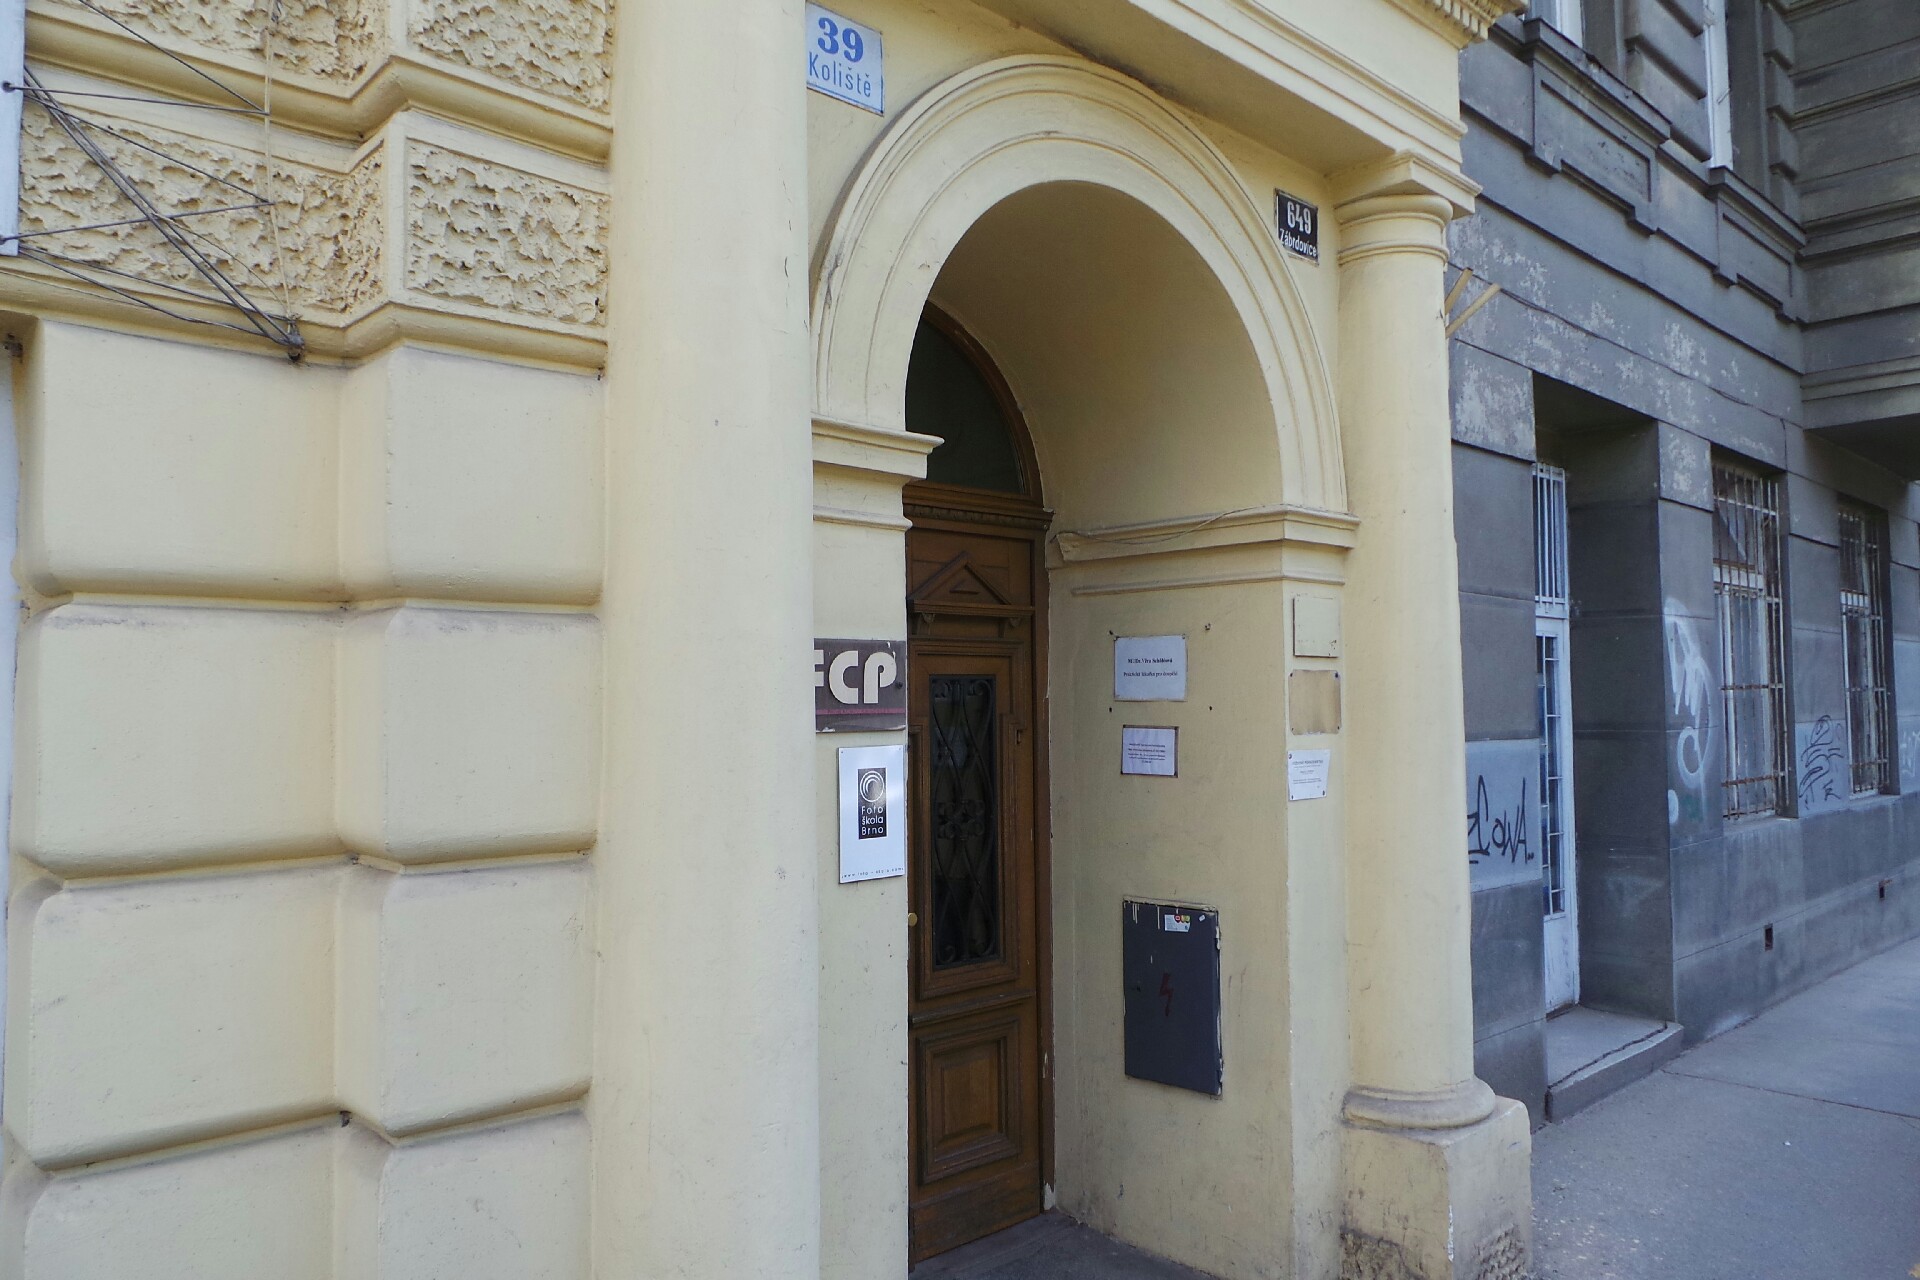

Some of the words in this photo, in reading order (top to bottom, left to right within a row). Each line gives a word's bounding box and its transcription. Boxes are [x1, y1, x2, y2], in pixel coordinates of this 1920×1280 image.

[818, 17, 864, 62] 39
[809, 51, 871, 98] Koliště
[1287, 201, 1312, 235] 649
[1280, 228, 1317, 257] Zábrdovice
[861, 805, 883, 815] Foto
[861, 815, 884, 825] škola
[861, 826, 884, 836] Brno
